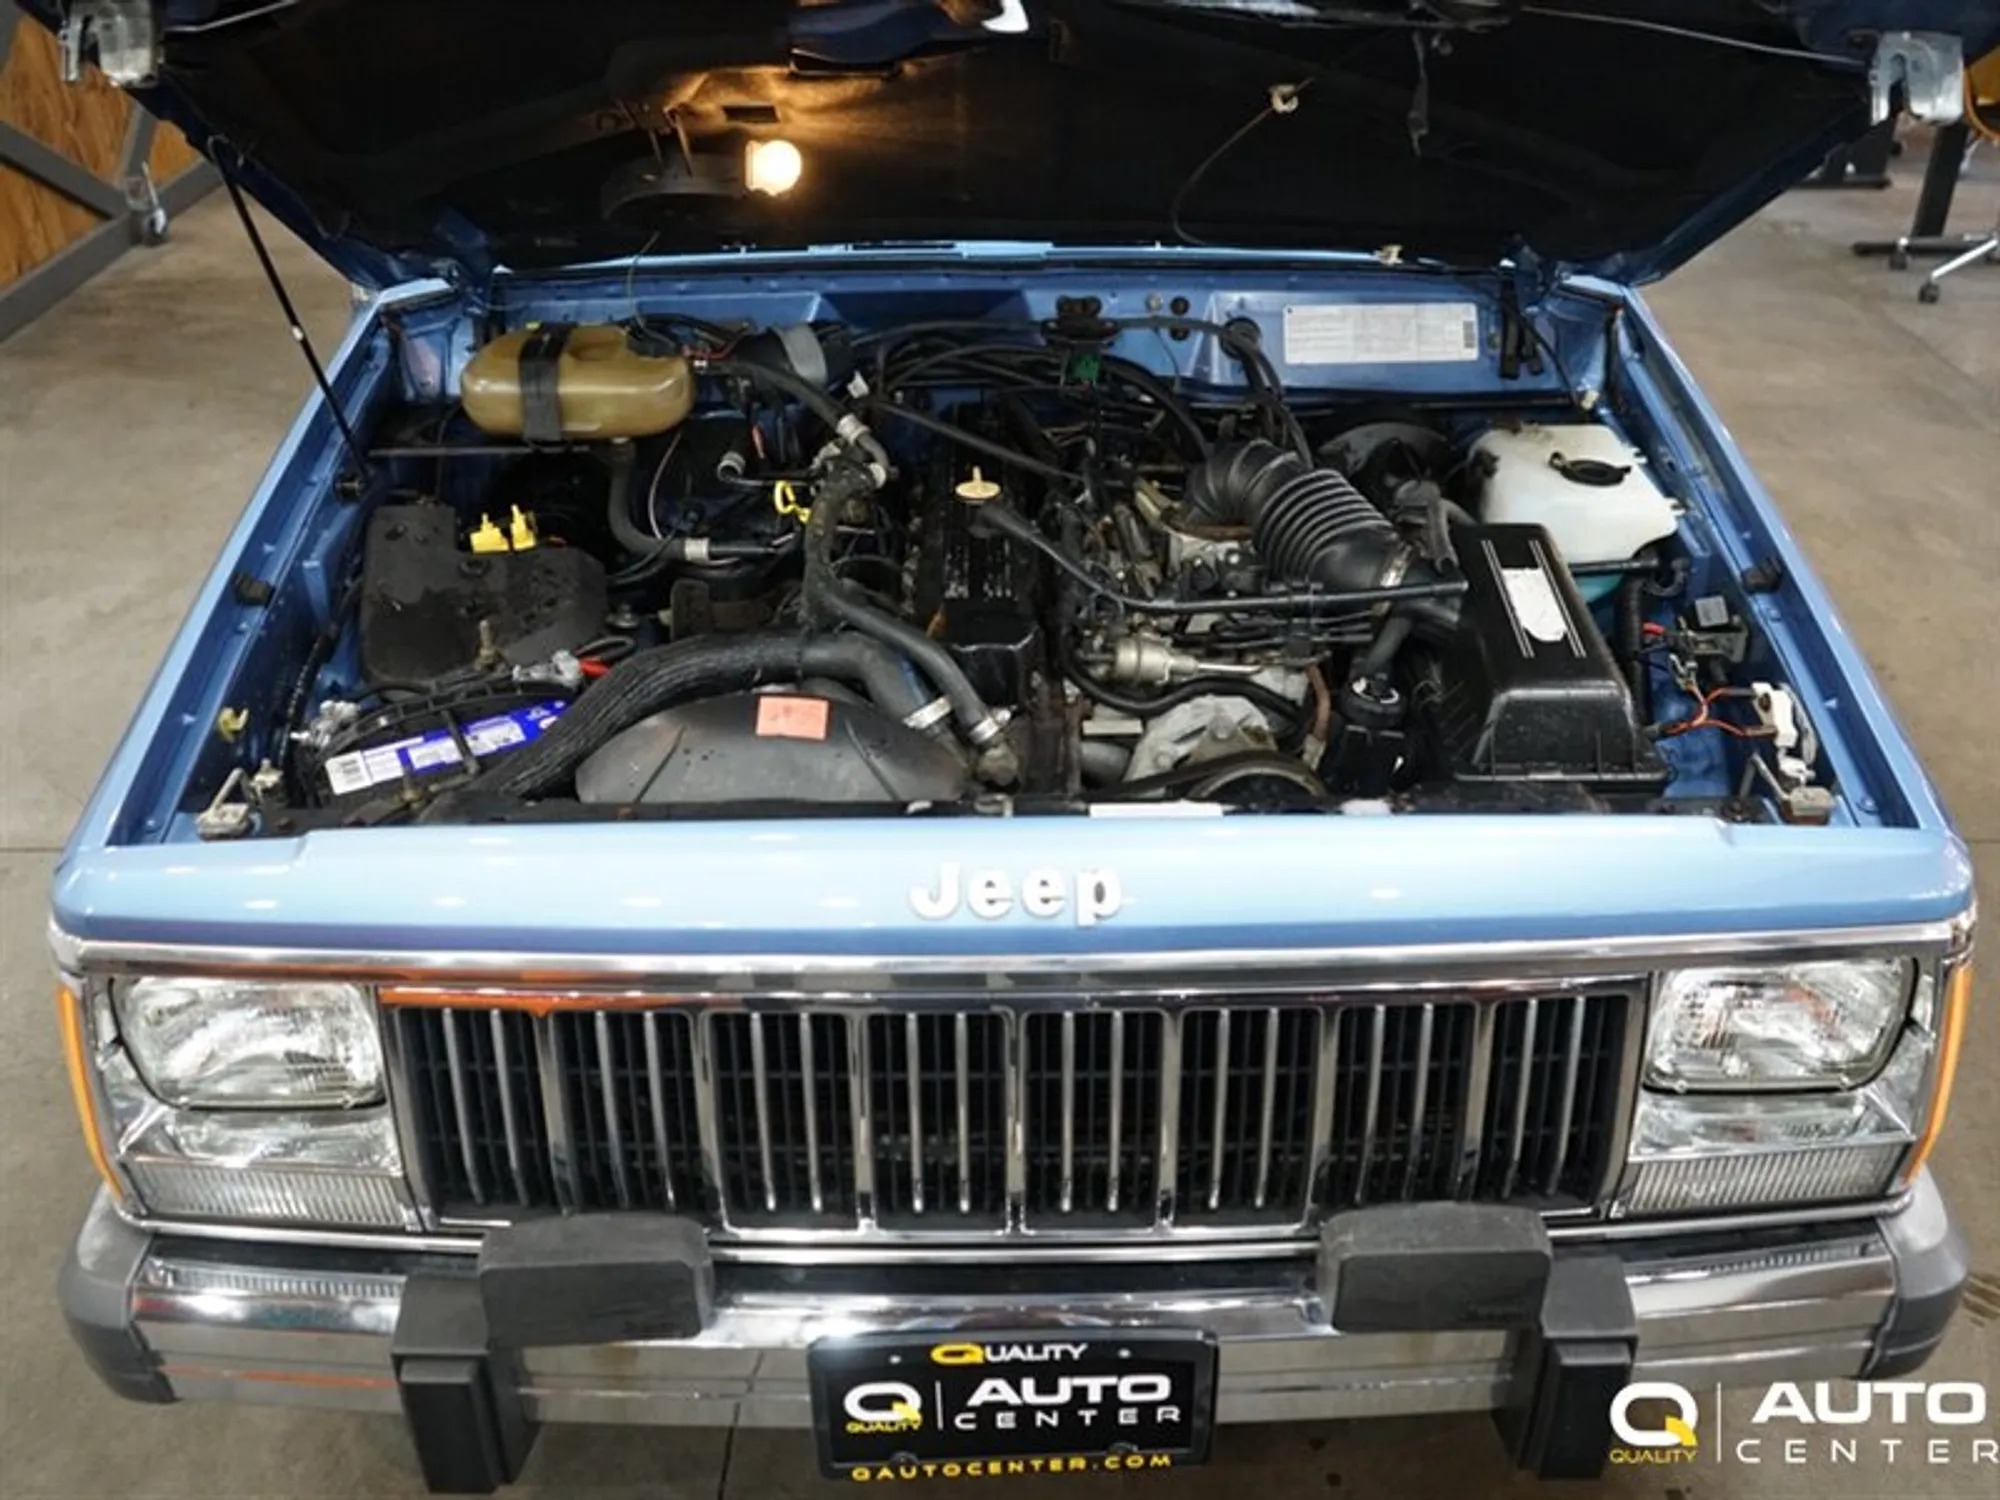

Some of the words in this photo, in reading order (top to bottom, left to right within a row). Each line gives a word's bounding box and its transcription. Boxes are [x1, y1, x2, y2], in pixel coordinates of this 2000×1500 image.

[908, 860, 1124, 926] Jeep
[930, 1343, 1087, 1365] QUALITY
[966, 1375, 1172, 1407] AUTO
[845, 1420, 922, 1434] QUALITY
[953, 1405, 1181, 1431] CENTER
[851, 1454, 1172, 1481] QAUTOCENTER.COM
